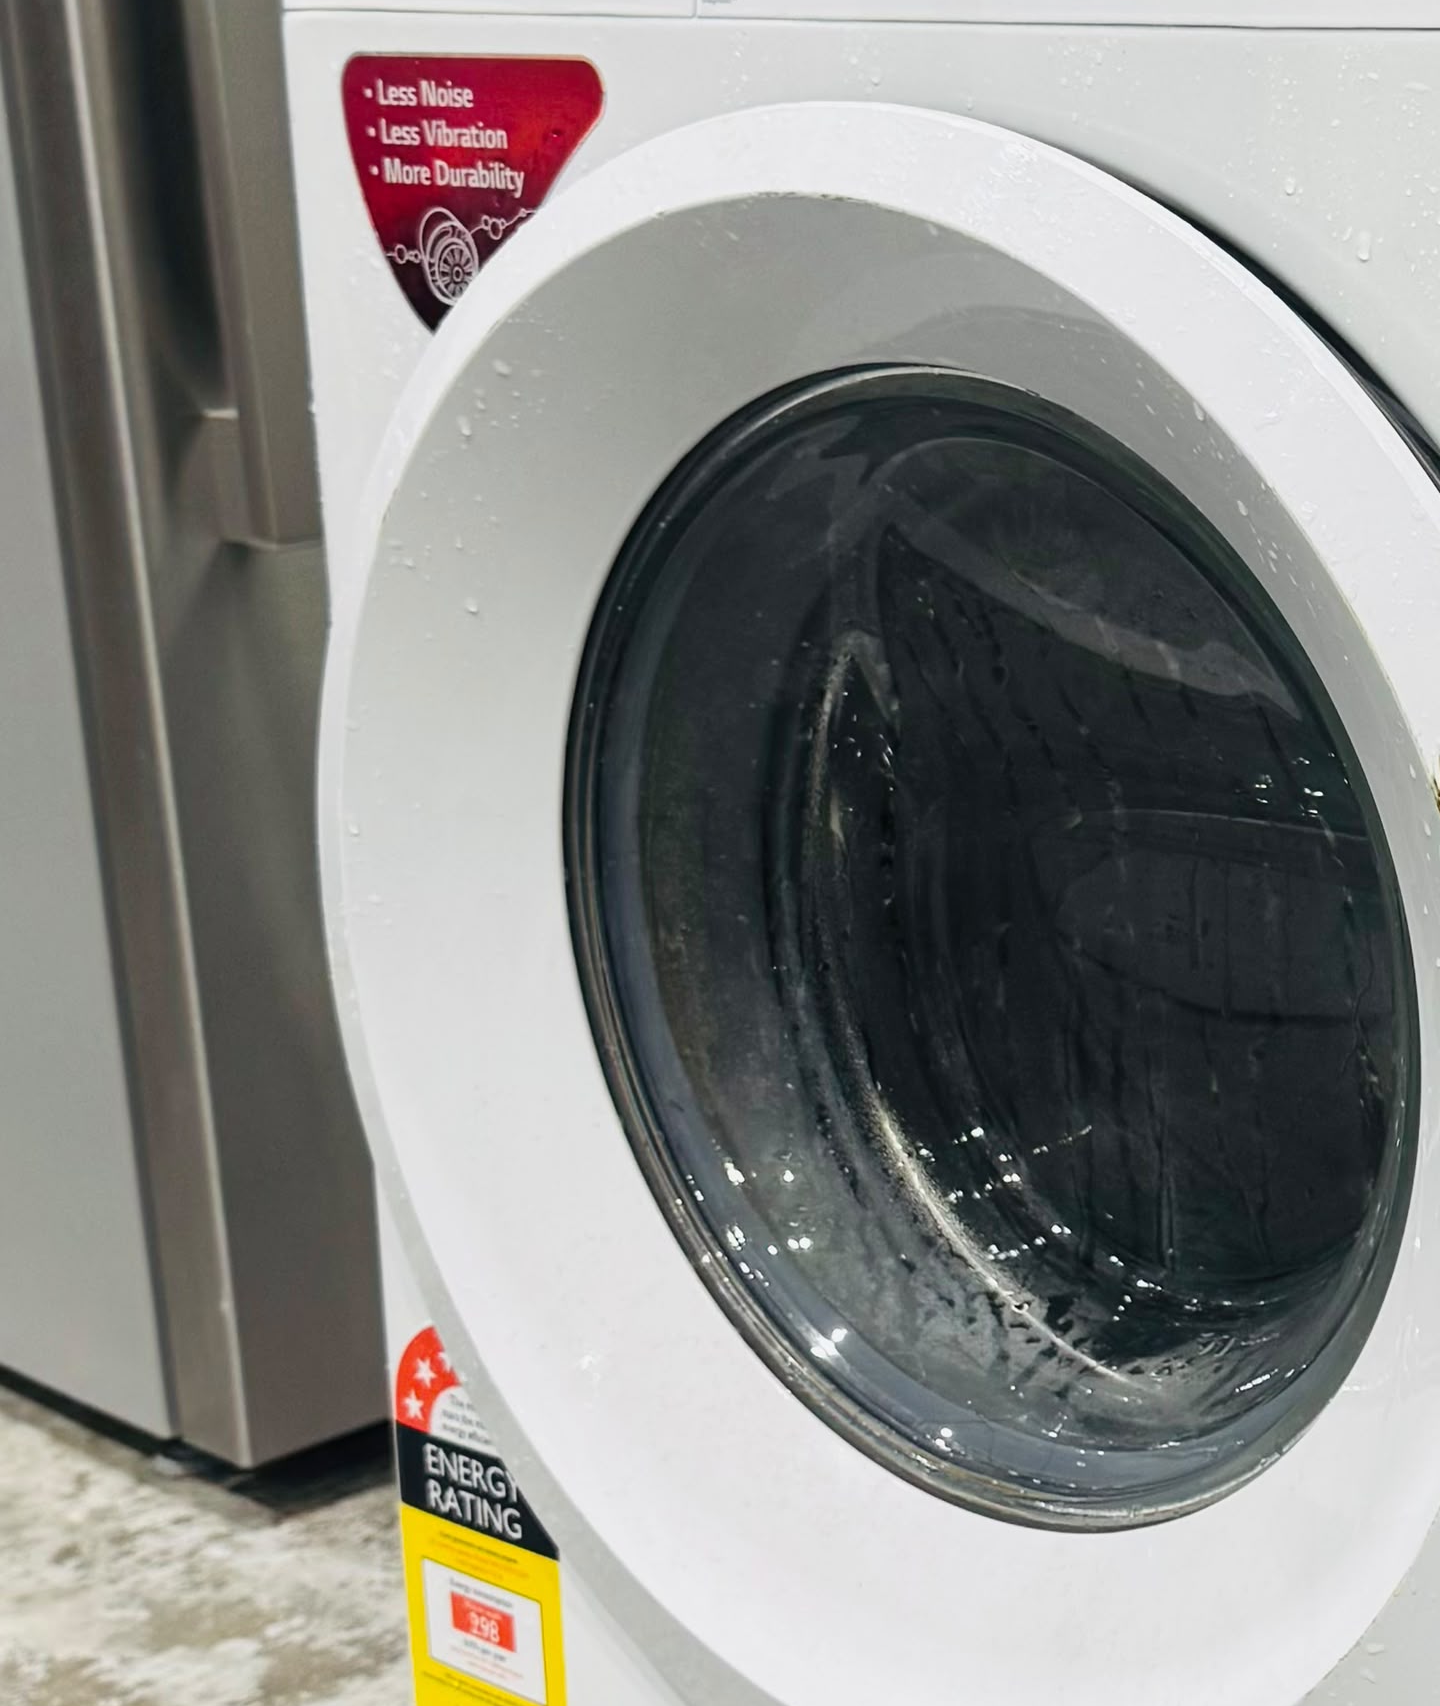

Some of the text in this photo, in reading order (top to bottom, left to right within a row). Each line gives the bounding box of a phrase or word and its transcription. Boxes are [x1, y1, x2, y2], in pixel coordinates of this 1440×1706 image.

[376, 78, 474, 108] Less Noise
[379, 117, 508, 150] Less Vibration
[383, 157, 525, 198] More Durability
[422, 1441, 518, 1503] ENERGY
[426, 1478, 523, 1541] RATING
